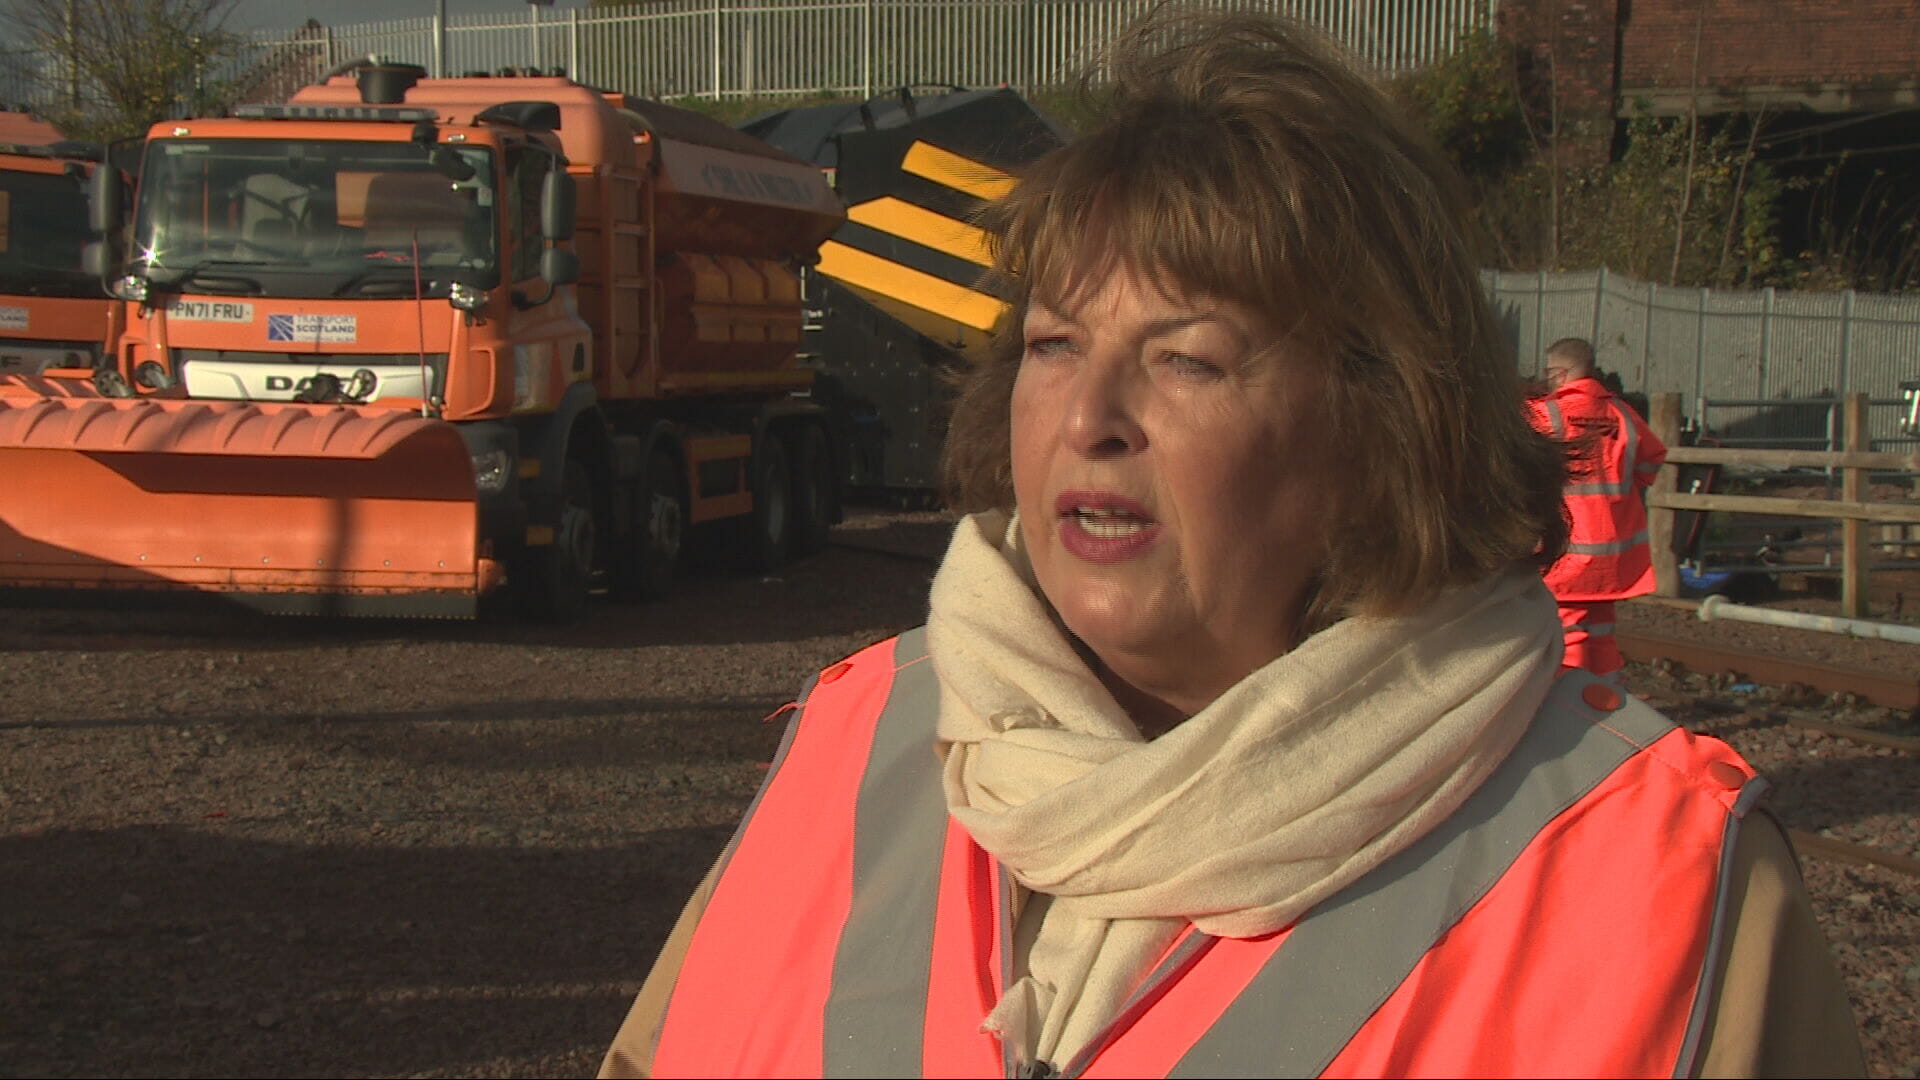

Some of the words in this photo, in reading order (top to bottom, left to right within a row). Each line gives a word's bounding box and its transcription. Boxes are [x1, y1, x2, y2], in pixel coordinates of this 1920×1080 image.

[175, 302, 209, 317] PN71
[213, 303, 244, 319] FRU
[297, 314, 354, 324] TRANSPORT
[296, 324, 355, 333] SCOTLAND
